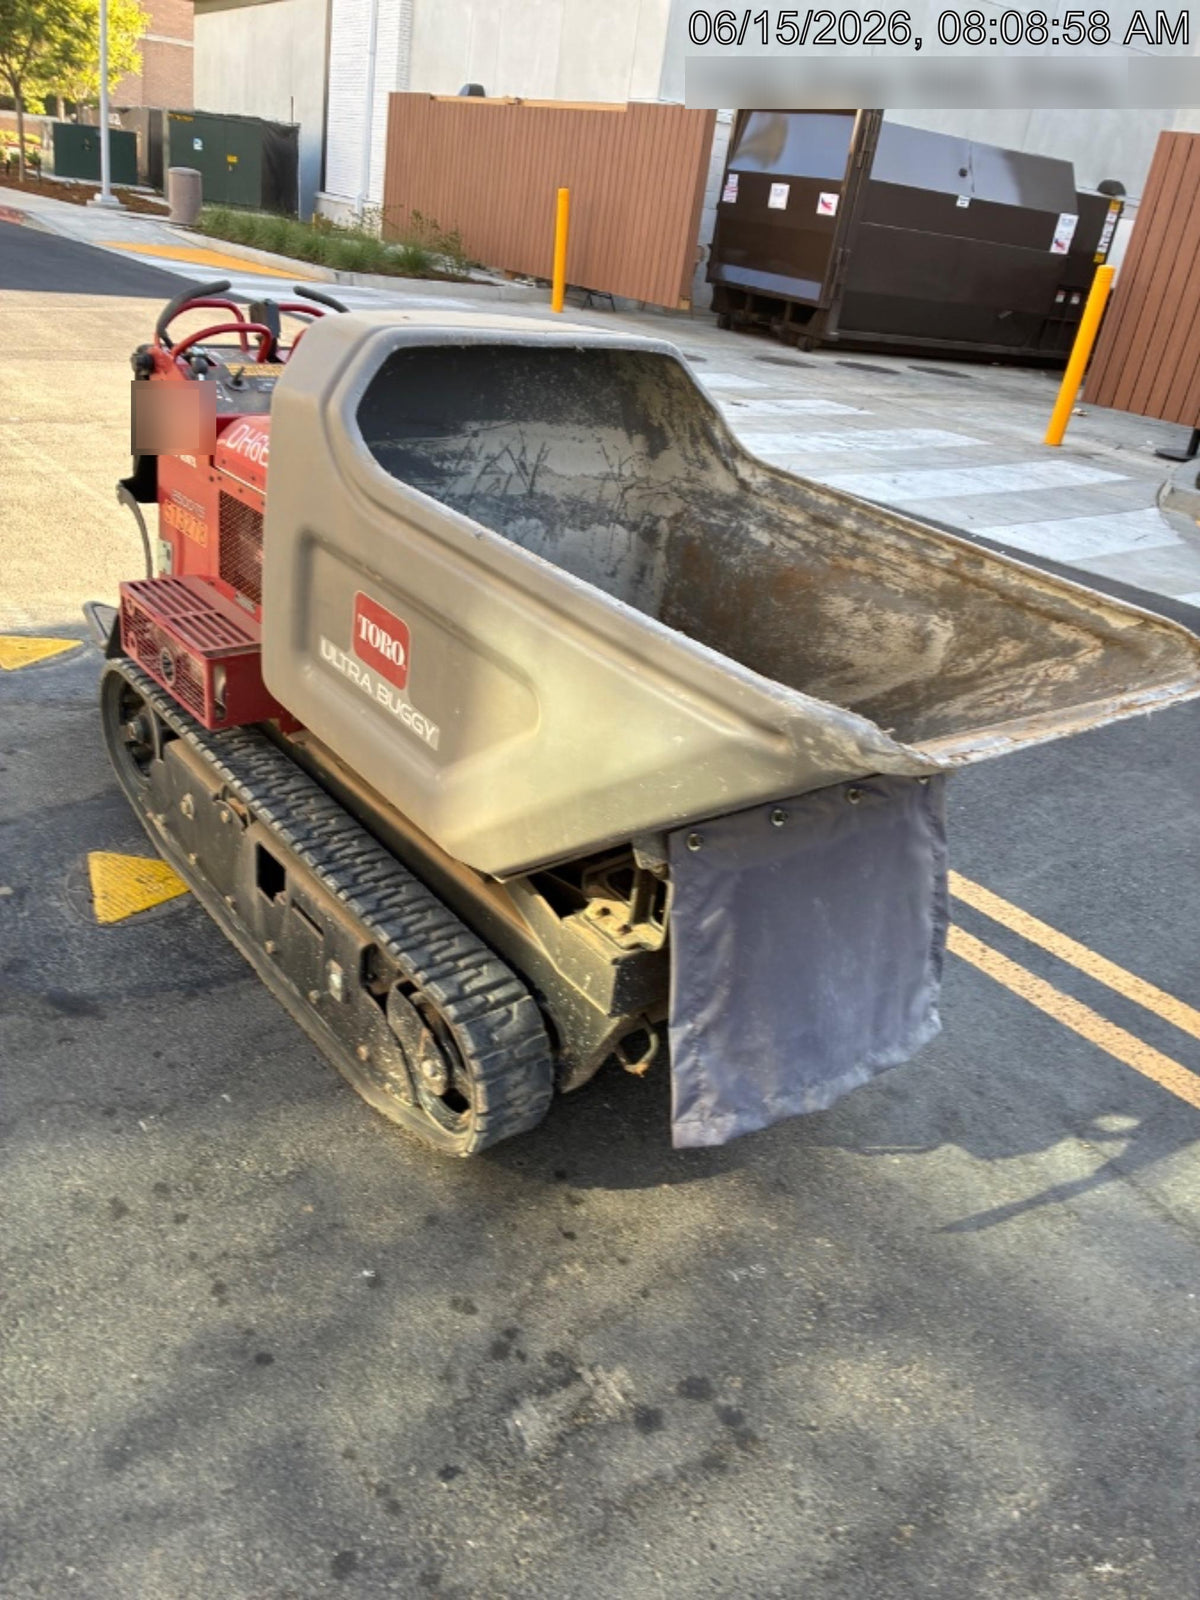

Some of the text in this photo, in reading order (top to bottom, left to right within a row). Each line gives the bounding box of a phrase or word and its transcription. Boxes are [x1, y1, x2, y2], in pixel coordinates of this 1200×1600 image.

[357, 613, 405, 667] TORO
[319, 637, 436, 743] ULTRA BUGGY
